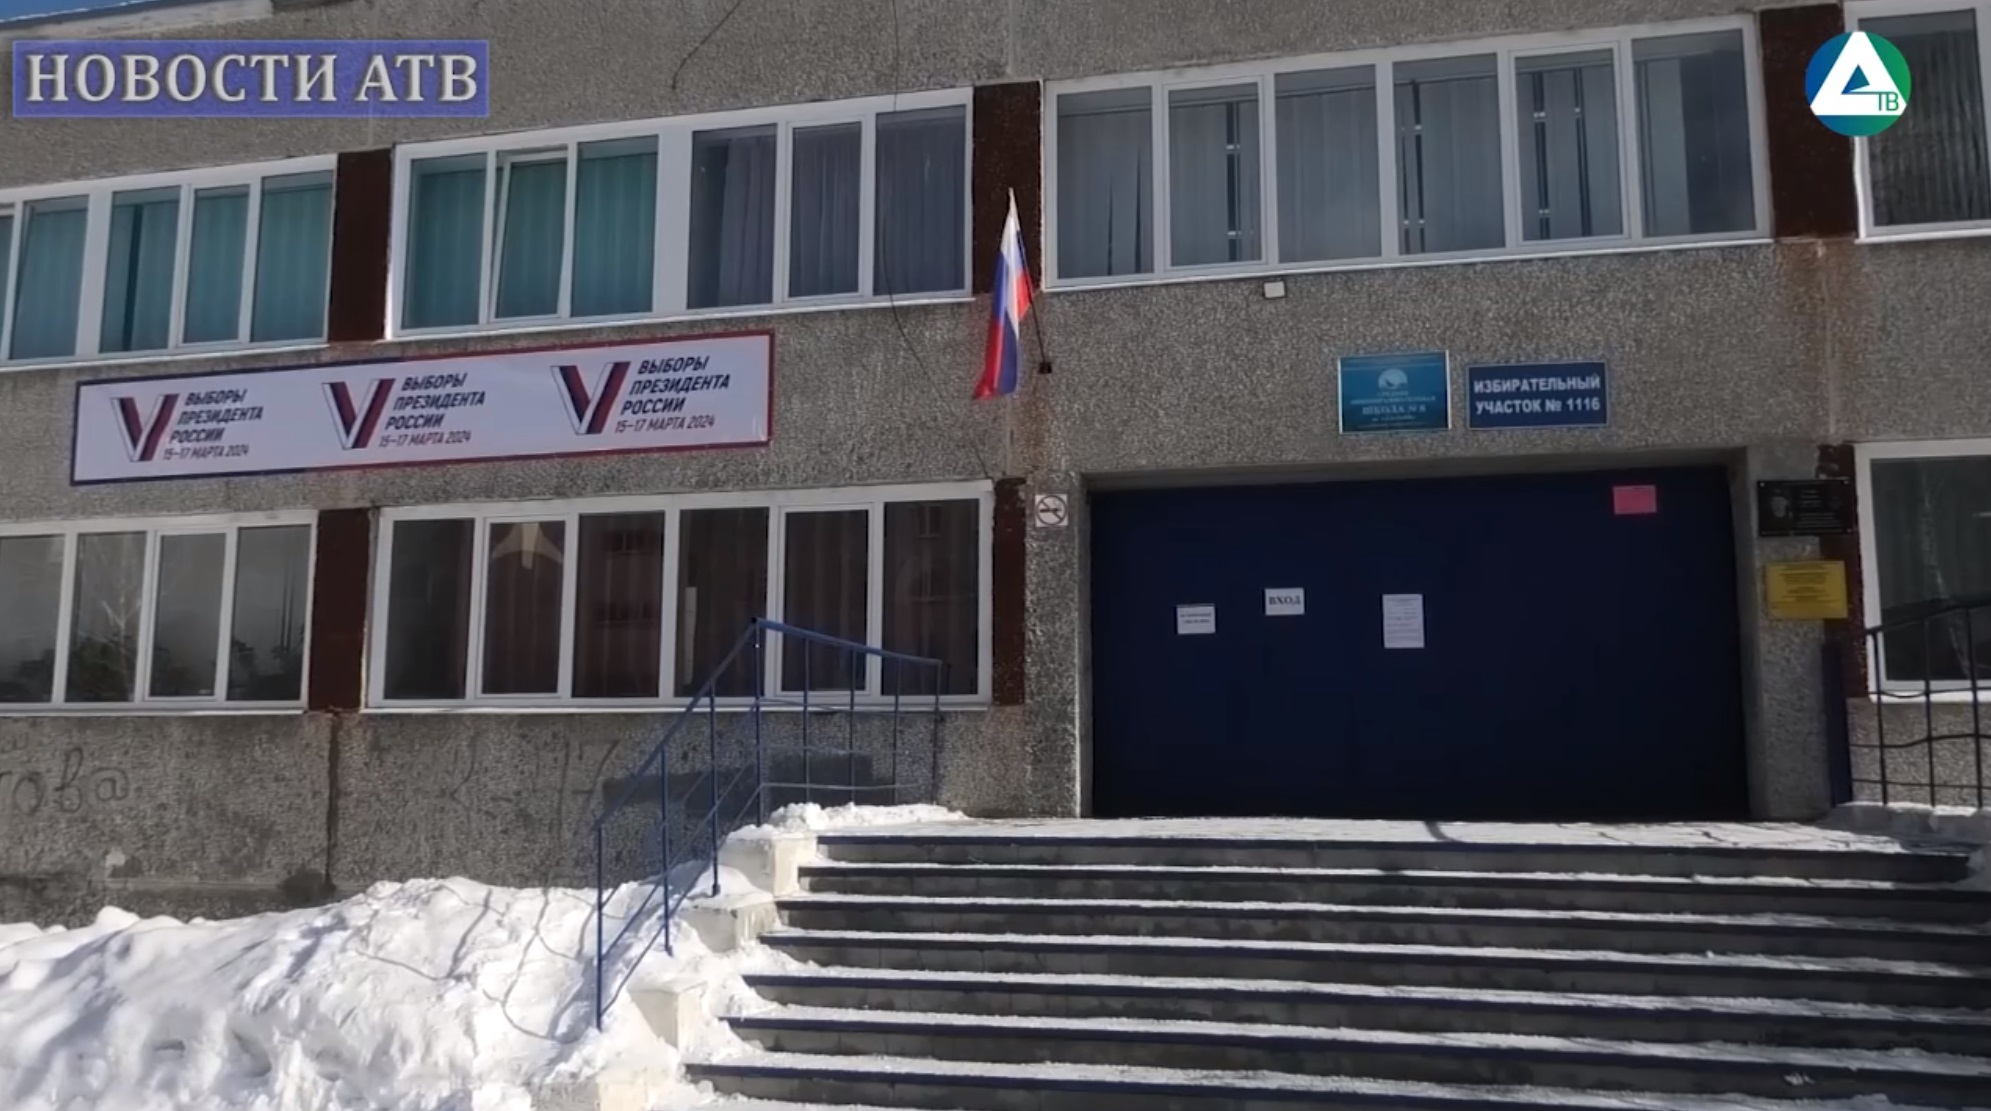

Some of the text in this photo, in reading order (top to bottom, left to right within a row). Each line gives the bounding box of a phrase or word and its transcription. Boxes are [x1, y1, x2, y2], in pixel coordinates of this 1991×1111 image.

[637, 355, 710, 375] ВЫБОРЫ
[401, 372, 468, 391] ВЫБОРЫ
[629, 374, 731, 395] ПРЕЗИДЕНТА
[1473, 372, 1601, 393] ИЗБИРАТЕЛЬНЫЙ
[184, 388, 247, 407] ВЫБОРЫ
[393, 391, 486, 411] ПРЕЗИДЕНТА
[620, 397, 686, 416] РОССИИ
[1476, 397, 1600, 414] УЧАСТОК № 1116
[177, 405, 264, 426] ПРЕЗИДЕНТА
[384, 413, 445, 430] РОССИИ
[647, 416, 686, 431] МАРТА
[687, 414, 716, 430] 2024
[169, 427, 226, 444] РОССИИ
[408, 431, 444, 446] МАРТА
[445, 430, 472, 445] 2024
[191, 445, 224, 459] МАРТА
[225, 443, 249, 457] 2024
[1268, 595, 1301, 605] ВХОД
